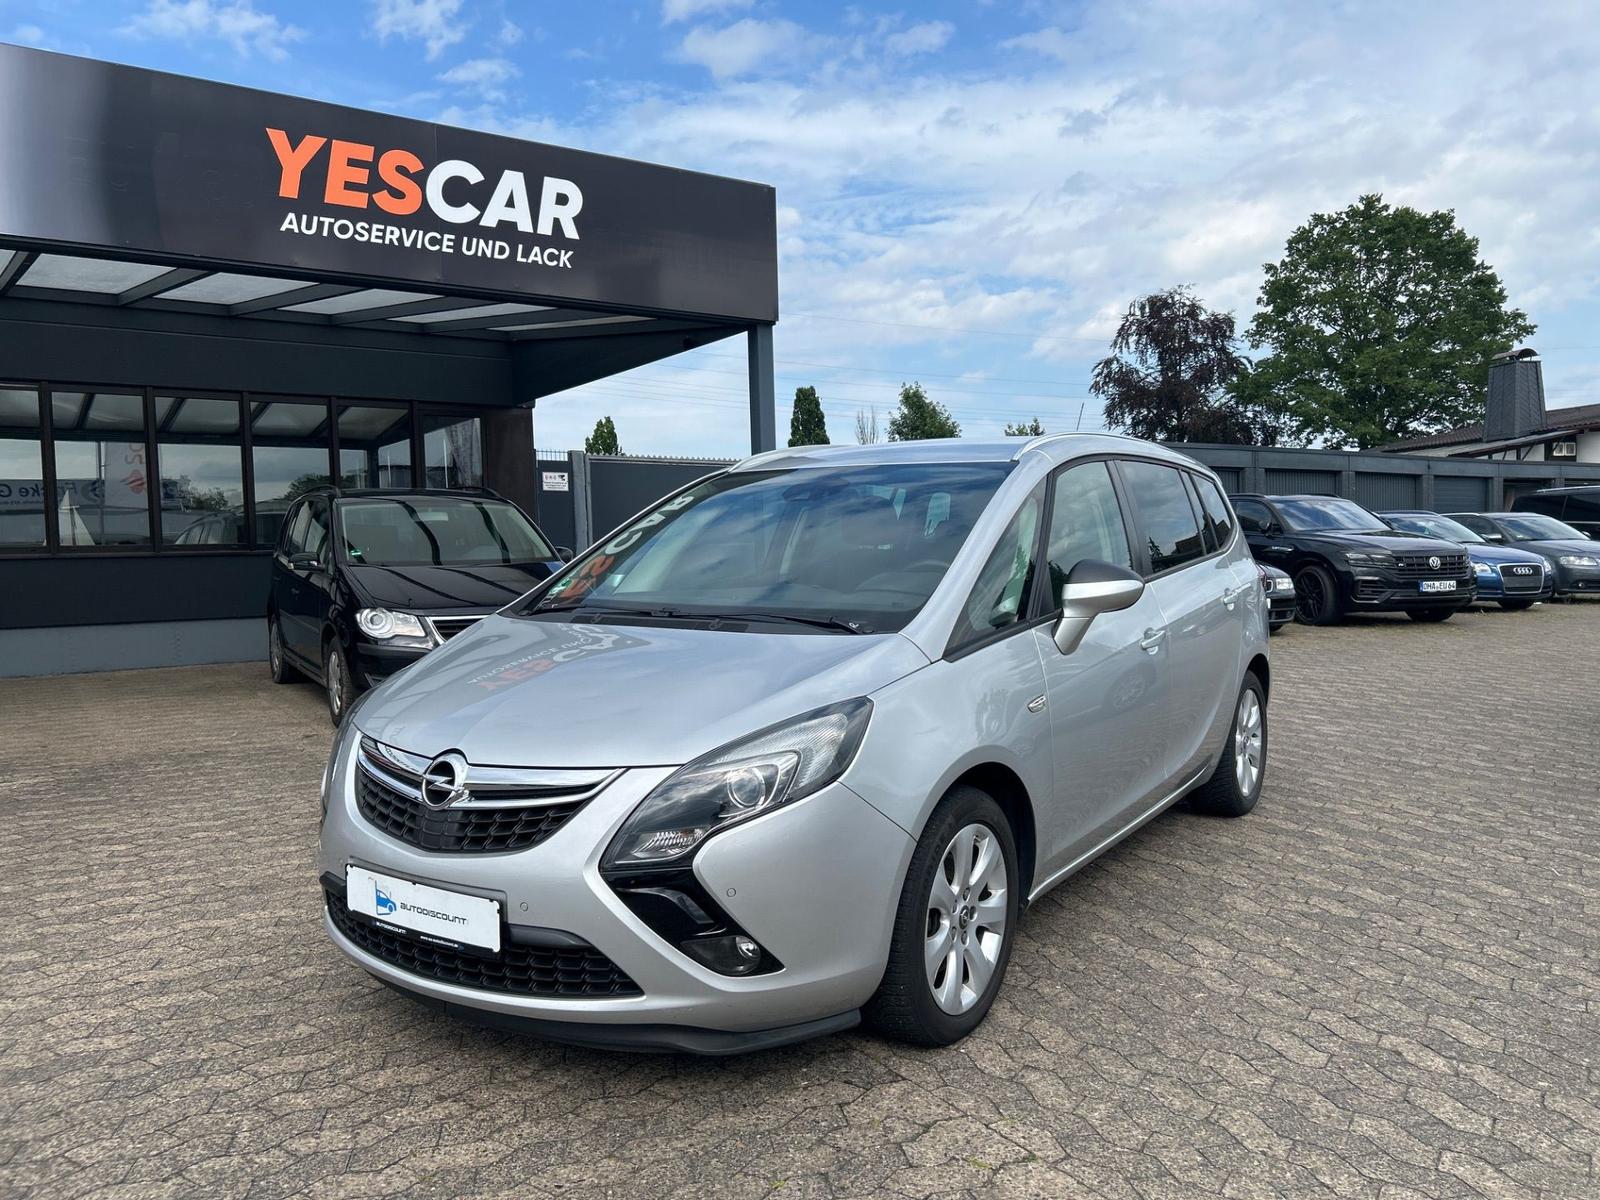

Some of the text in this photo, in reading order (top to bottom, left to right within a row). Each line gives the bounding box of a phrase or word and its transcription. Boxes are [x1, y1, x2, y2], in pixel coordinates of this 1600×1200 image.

[266, 128, 583, 240] YESCAR
[279, 212, 574, 269] AUTOSERVICE UND LACK
